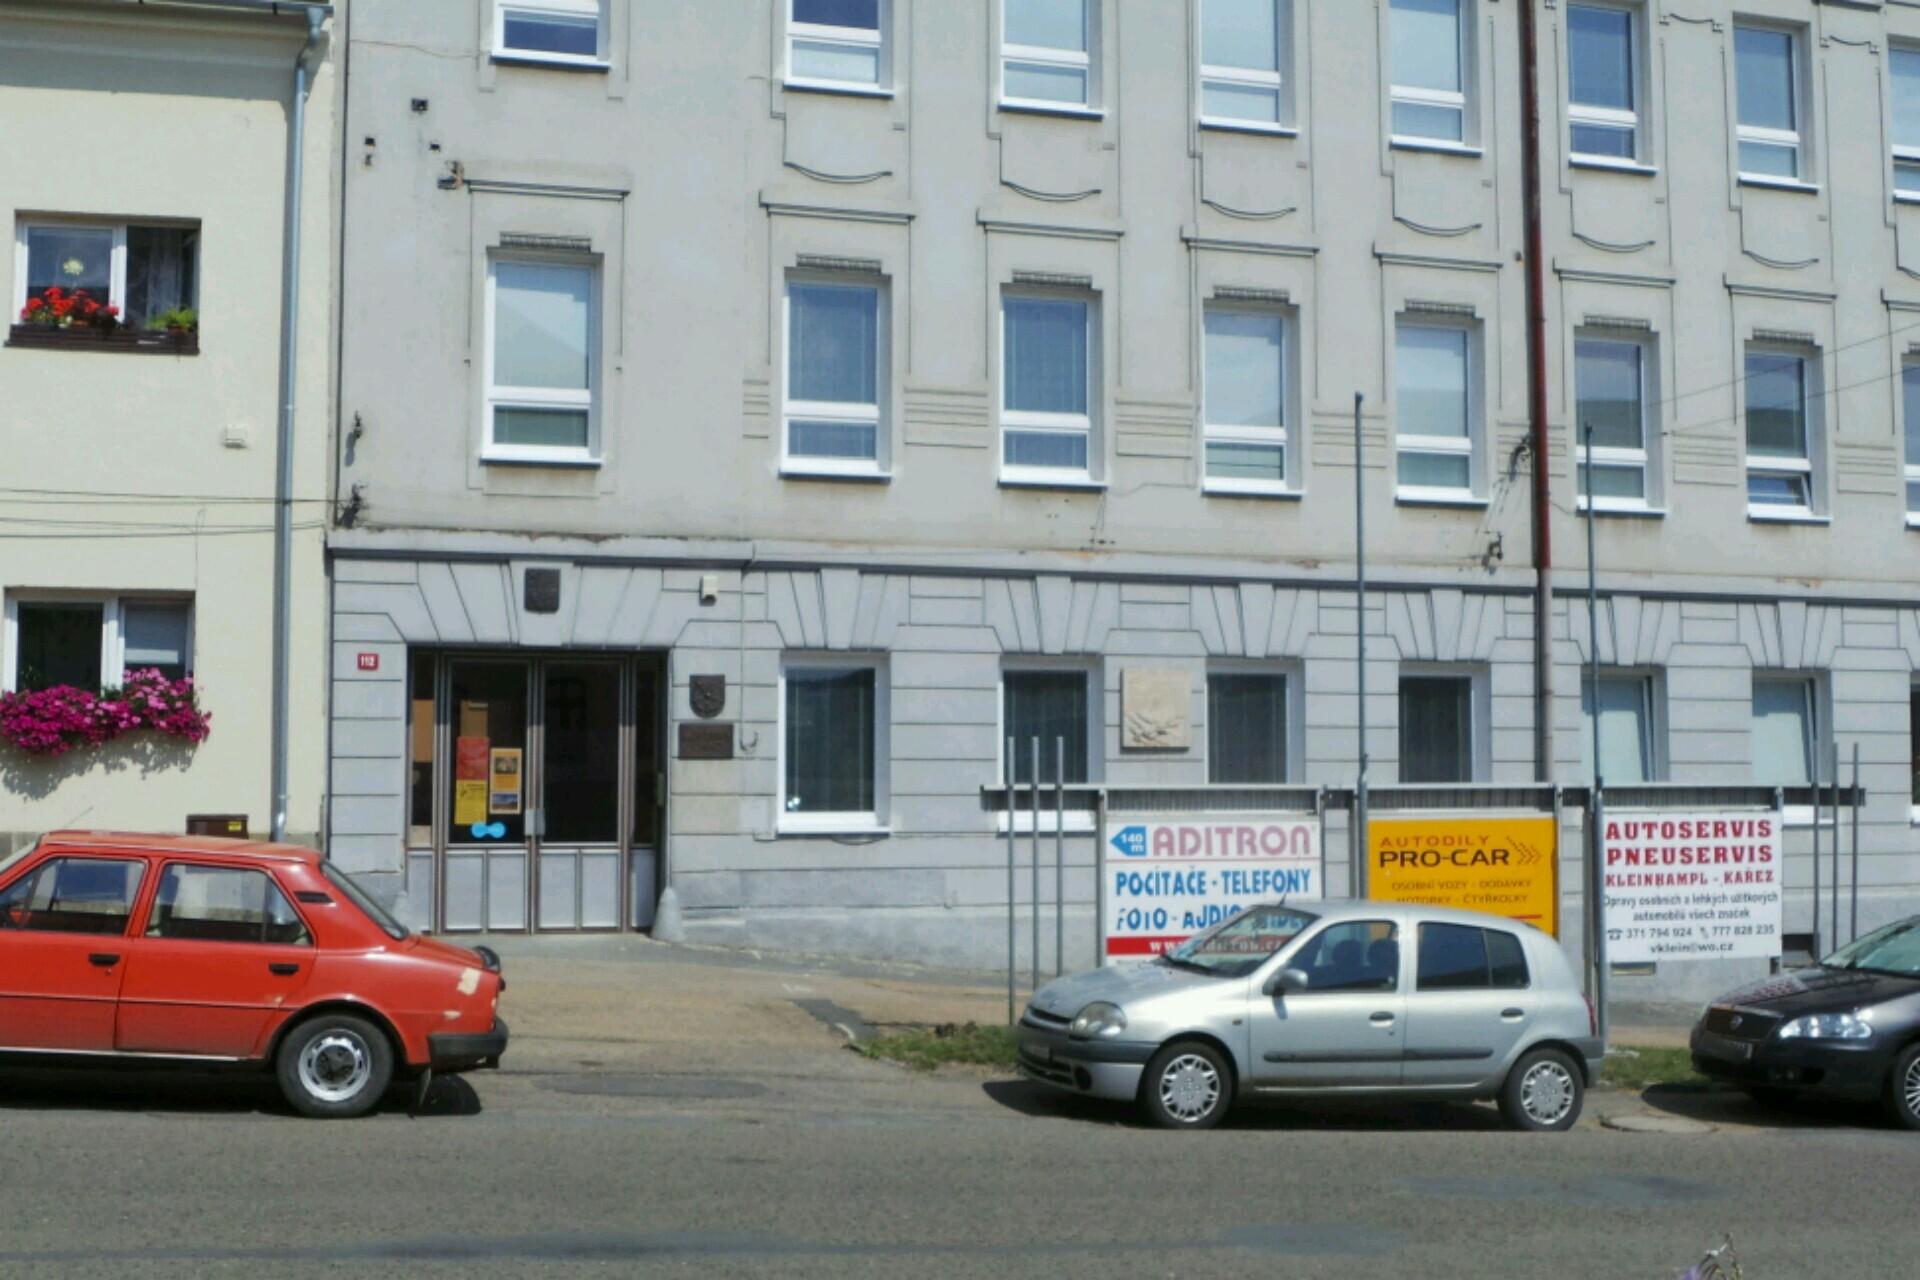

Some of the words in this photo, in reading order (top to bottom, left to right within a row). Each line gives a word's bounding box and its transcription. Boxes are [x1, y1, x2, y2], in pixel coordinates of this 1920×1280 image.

[1120, 833, 1143, 844] 140
[1152, 825, 1310, 856] ADITRON
[1605, 819, 1772, 841] AUTOSERVIS
[1379, 848, 1510, 868] PRO-CAR
[1606, 844, 1773, 866] PNEUSERVIS
[1221, 869, 1311, 896] TELEFONY
[1605, 872, 1708, 887] KLEINHAMPL
[1626, 929, 1646, 939] 371
[1712, 926, 1731, 936] 777
[1756, 924, 1775, 935] 235
